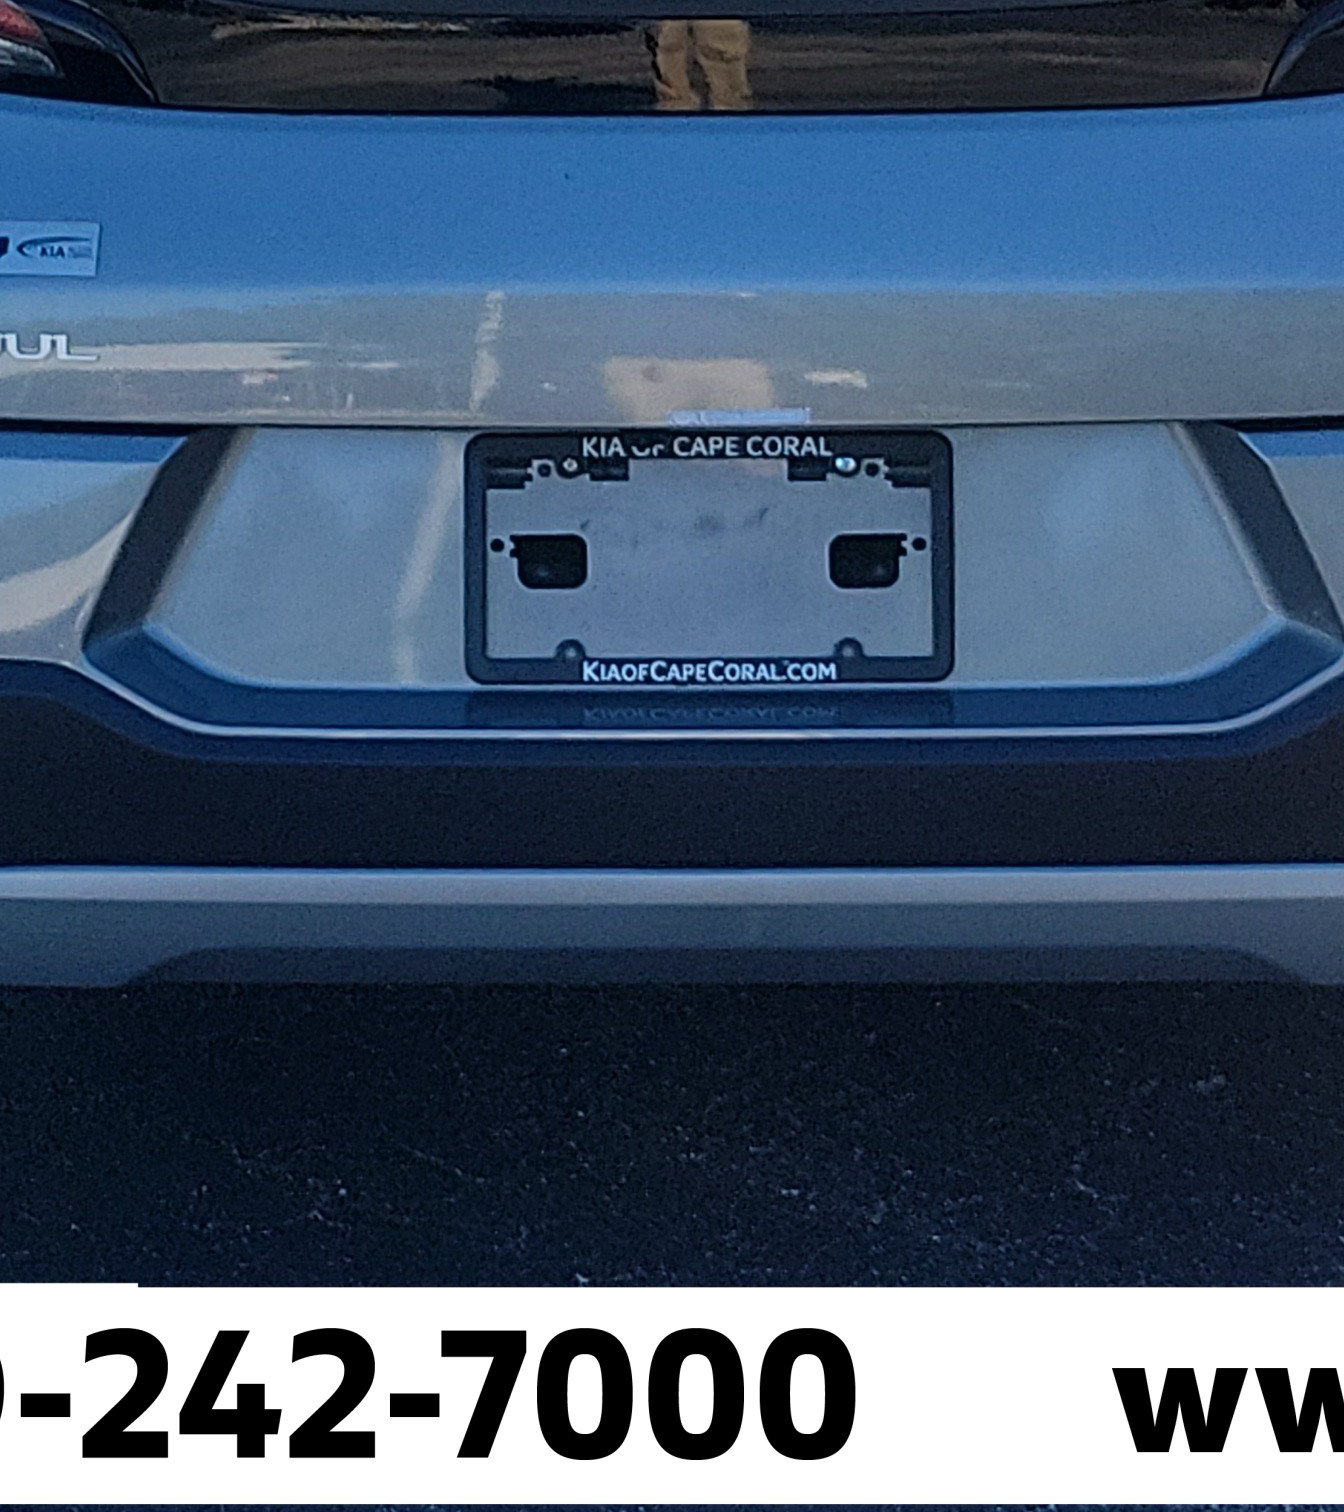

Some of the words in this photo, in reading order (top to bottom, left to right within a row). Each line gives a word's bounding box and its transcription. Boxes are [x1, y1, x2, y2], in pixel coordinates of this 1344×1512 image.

[582, 436, 627, 458] KIA
[672, 436, 740, 458] CAPE
[746, 435, 833, 458] CORAL
